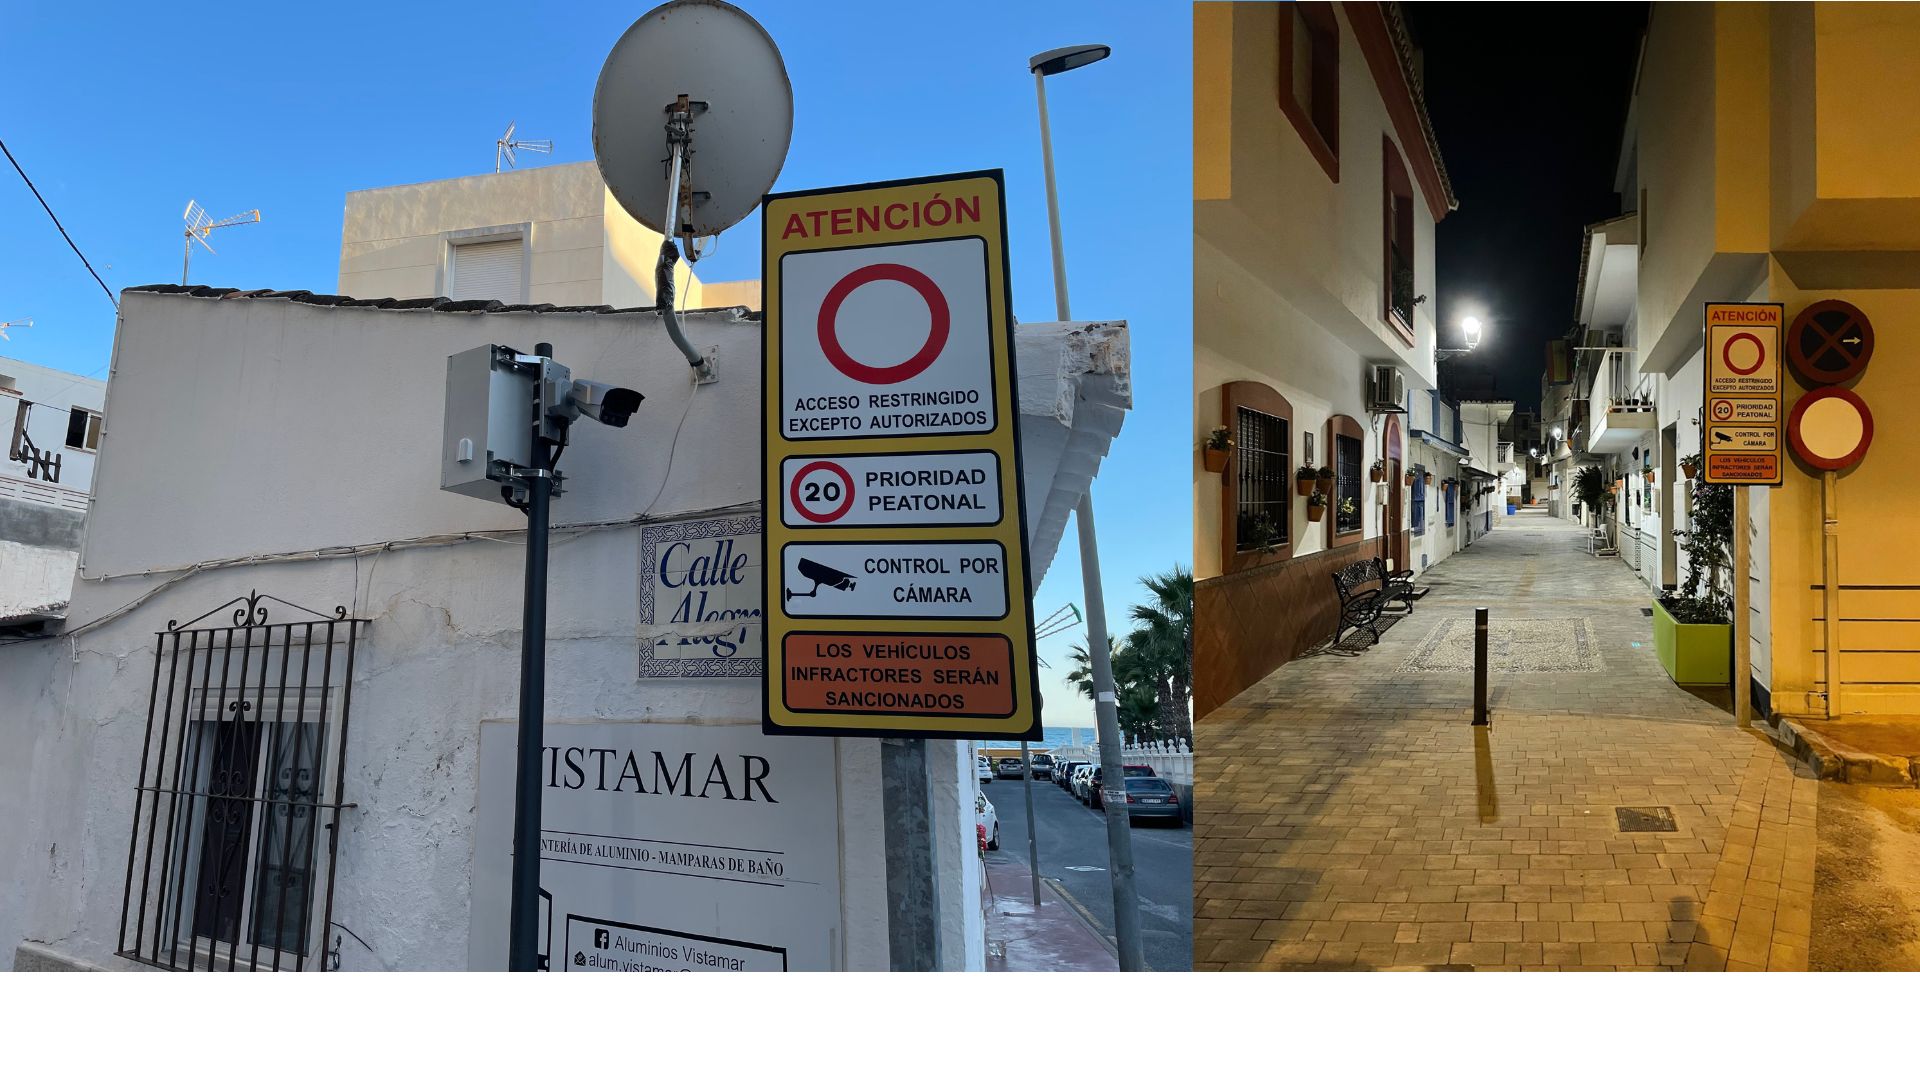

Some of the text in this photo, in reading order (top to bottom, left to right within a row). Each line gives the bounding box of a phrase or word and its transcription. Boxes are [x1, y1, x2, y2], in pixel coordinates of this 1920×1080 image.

[781, 193, 981, 240] ATENCIÓN
[1711, 309, 1777, 322] ATENCIÓN
[795, 389, 979, 412] ACCESO RESTRINGIDO
[1717, 406, 1730, 414] 20
[789, 410, 987, 432] EXCEPTO AUTORIZADOS
[865, 468, 986, 488] PRIORIDAD
[804, 482, 841, 502] 20
[868, 494, 986, 511] PEATONAL
[660, 539, 748, 588] Calle
[864, 558, 999, 574] CONTROL POR
[893, 583, 972, 603] CÁMARA
[815, 641, 971, 661] LOS VEHÍCULOS
[791, 666, 999, 686] INFRACTORES SERÁN
[825, 691, 964, 710] SANCIONADOS
[540, 746, 780, 804] ISTAMAR
[540, 838, 577, 854] NTERÍA
[580, 842, 593, 856] DE
[594, 845, 650, 862] ALUMINIO
[658, 851, 725, 870] MAMPARAS
[728, 857, 745, 872] DE
[748, 858, 784, 877] BAÑO
[615, 935, 678, 960] Aluminios
[682, 946, 746, 972] Vistamar
